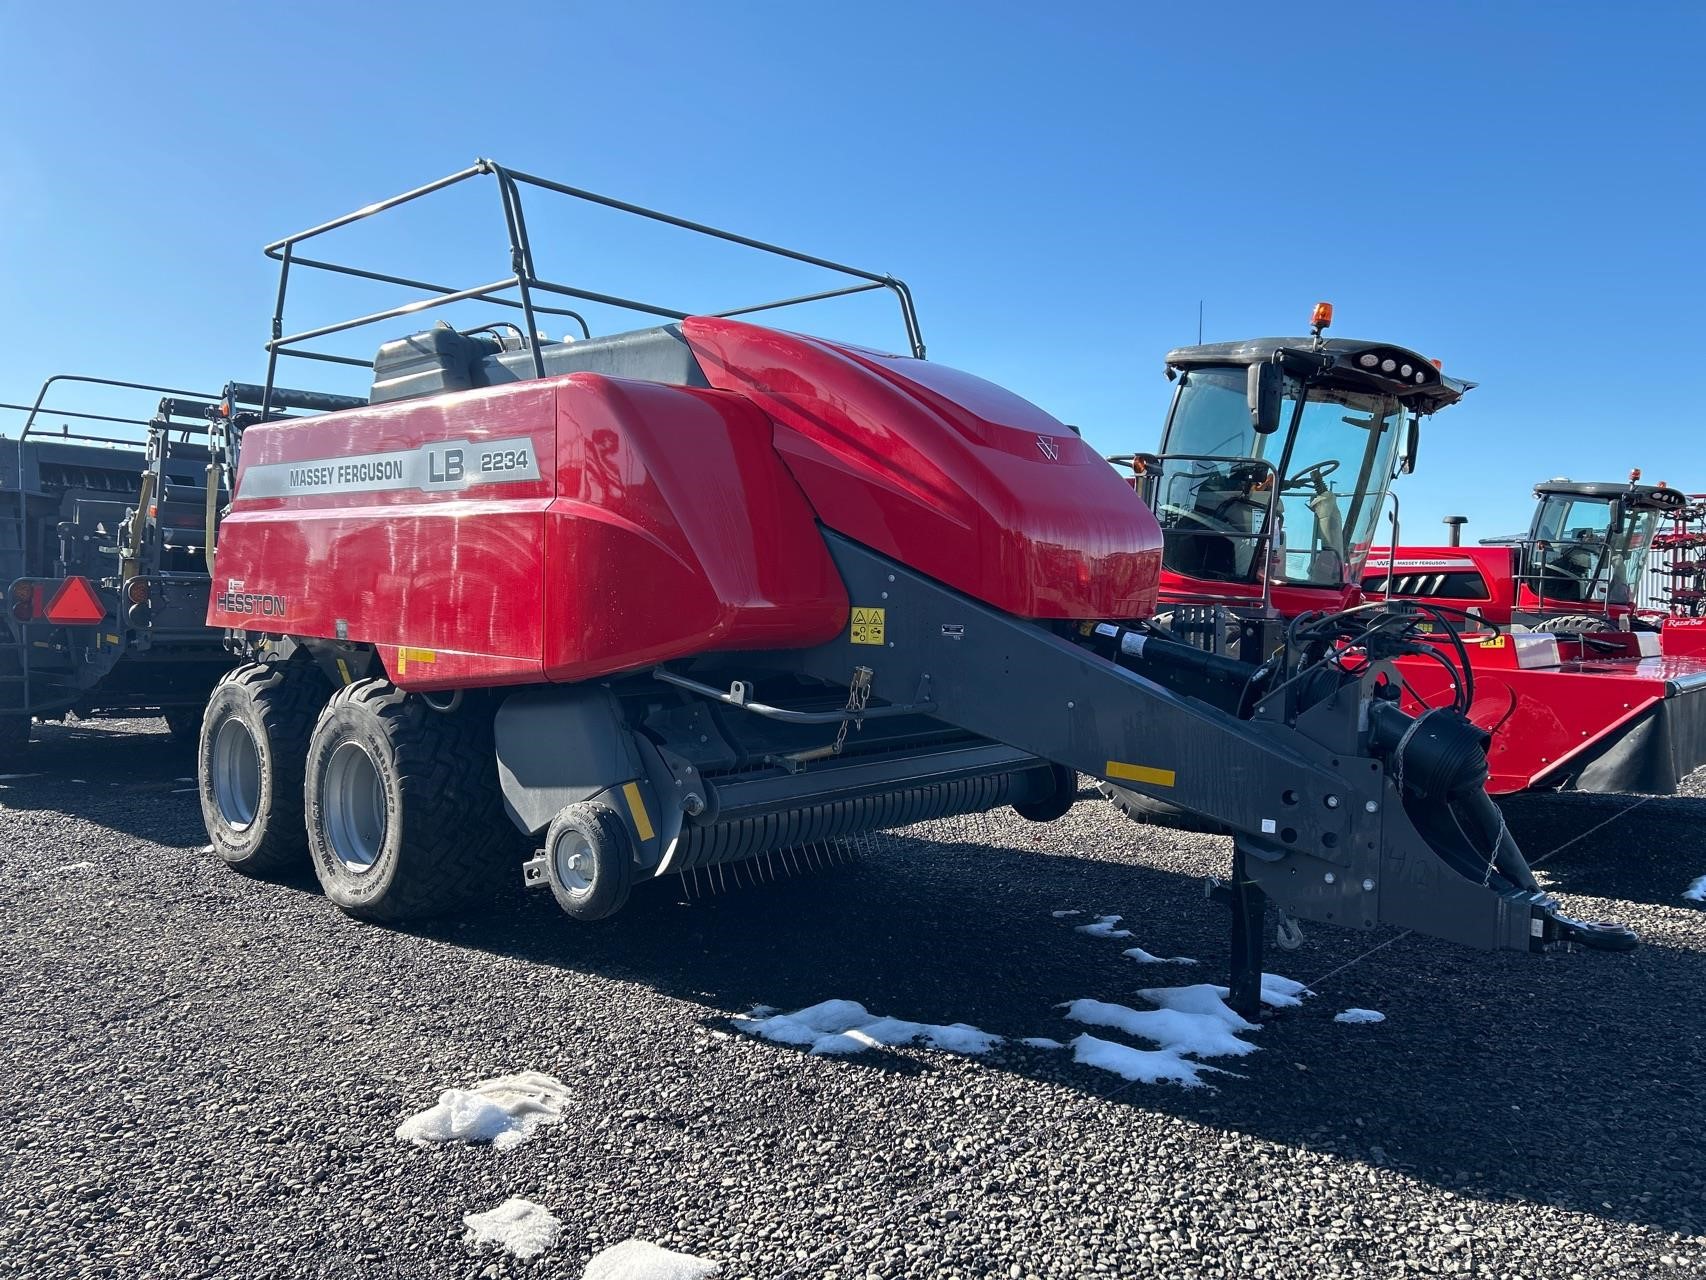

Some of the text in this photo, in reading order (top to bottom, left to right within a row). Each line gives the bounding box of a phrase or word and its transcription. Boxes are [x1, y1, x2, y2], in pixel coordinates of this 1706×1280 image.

[289, 449, 529, 488] MASSEY FERGUSON LB 2234
[216, 592, 286, 617] HESSTON
